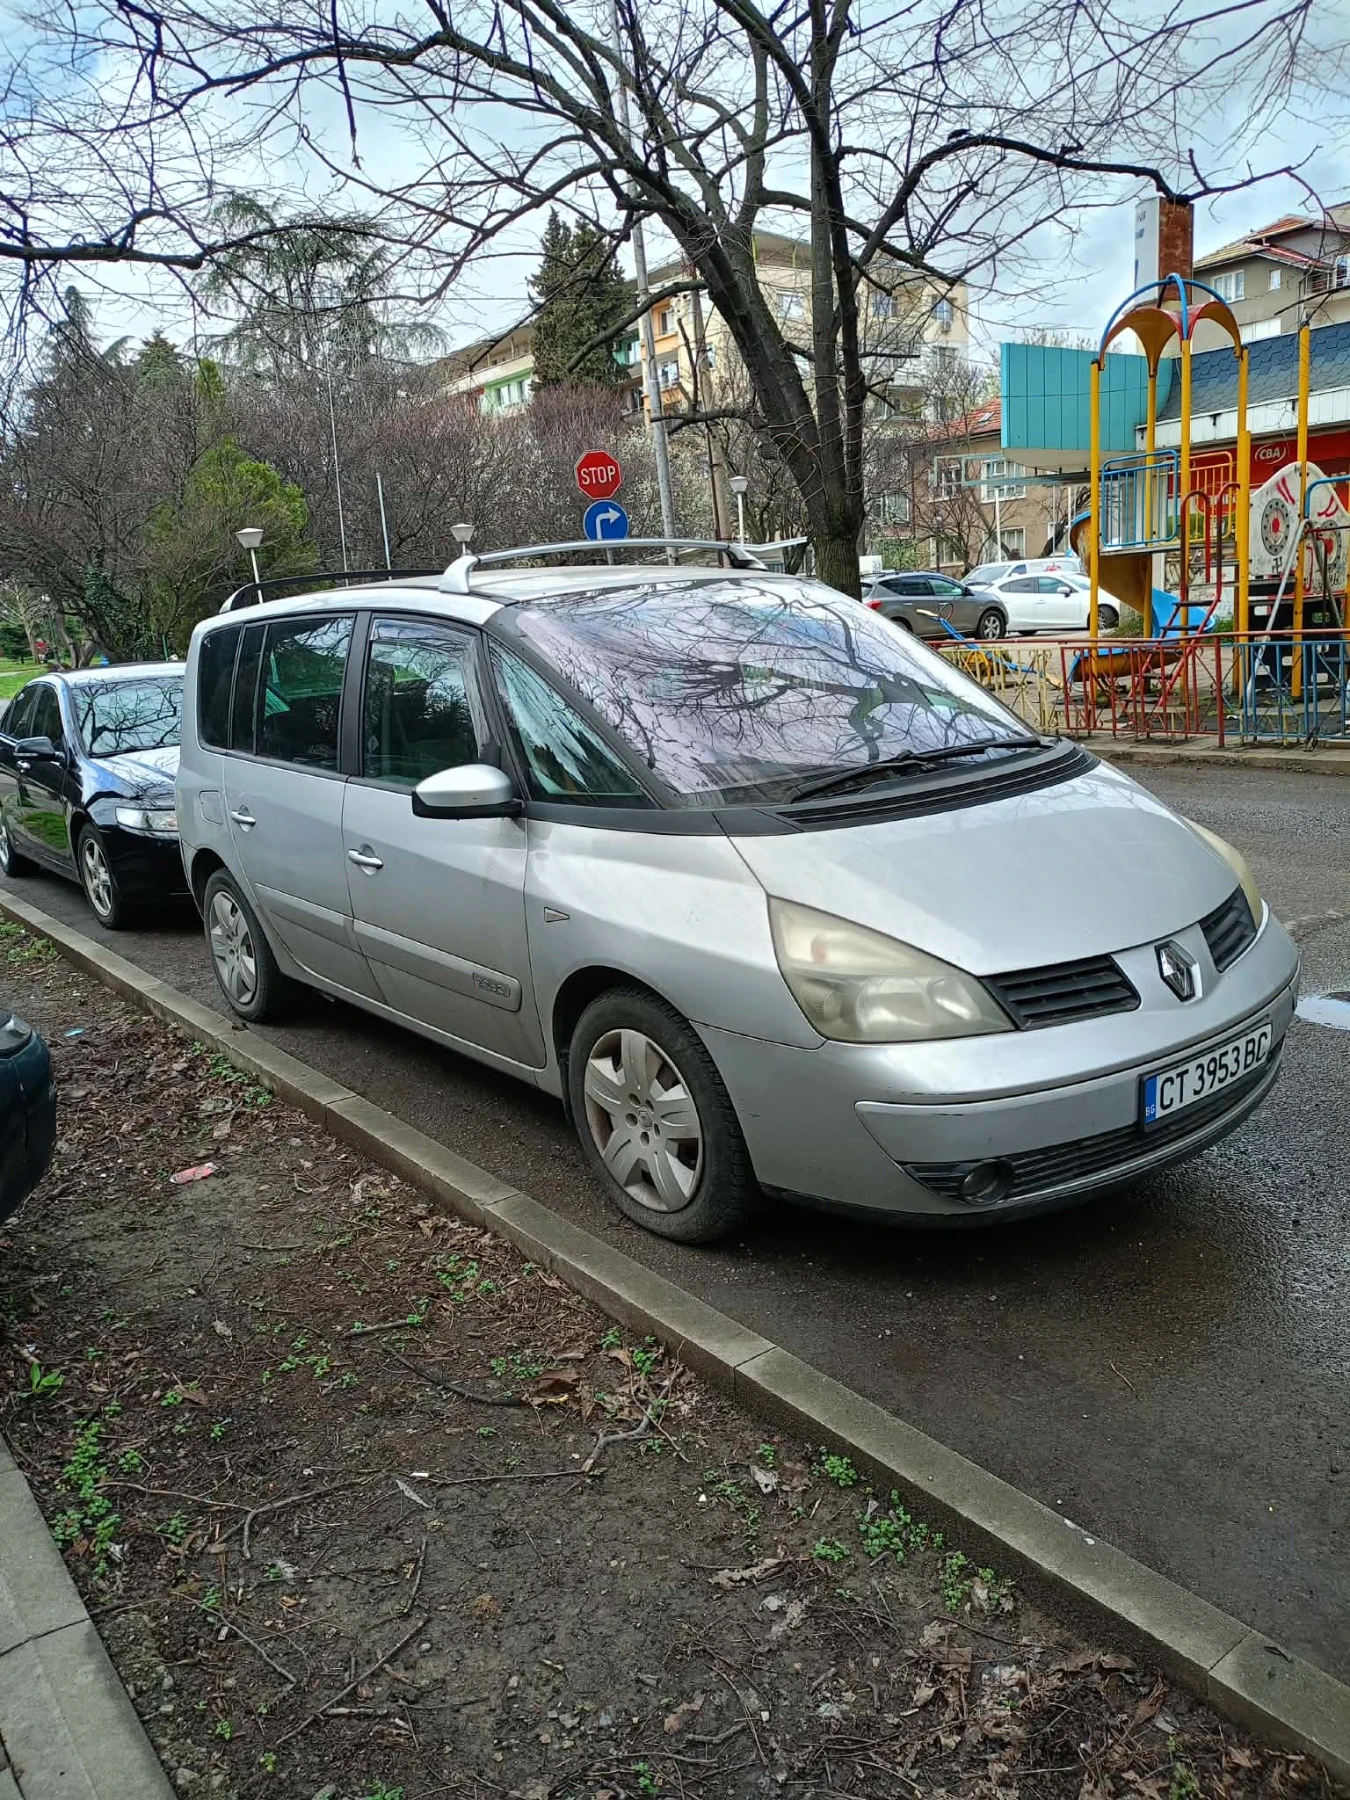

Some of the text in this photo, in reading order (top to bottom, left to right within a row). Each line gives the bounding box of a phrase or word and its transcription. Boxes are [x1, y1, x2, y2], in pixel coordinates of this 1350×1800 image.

[1260, 447, 1281, 460] CBA
[581, 465, 616, 485] STOP
[1160, 1031, 1268, 1111] CT 3953 BC
[1145, 1104, 1156, 1117] BG
